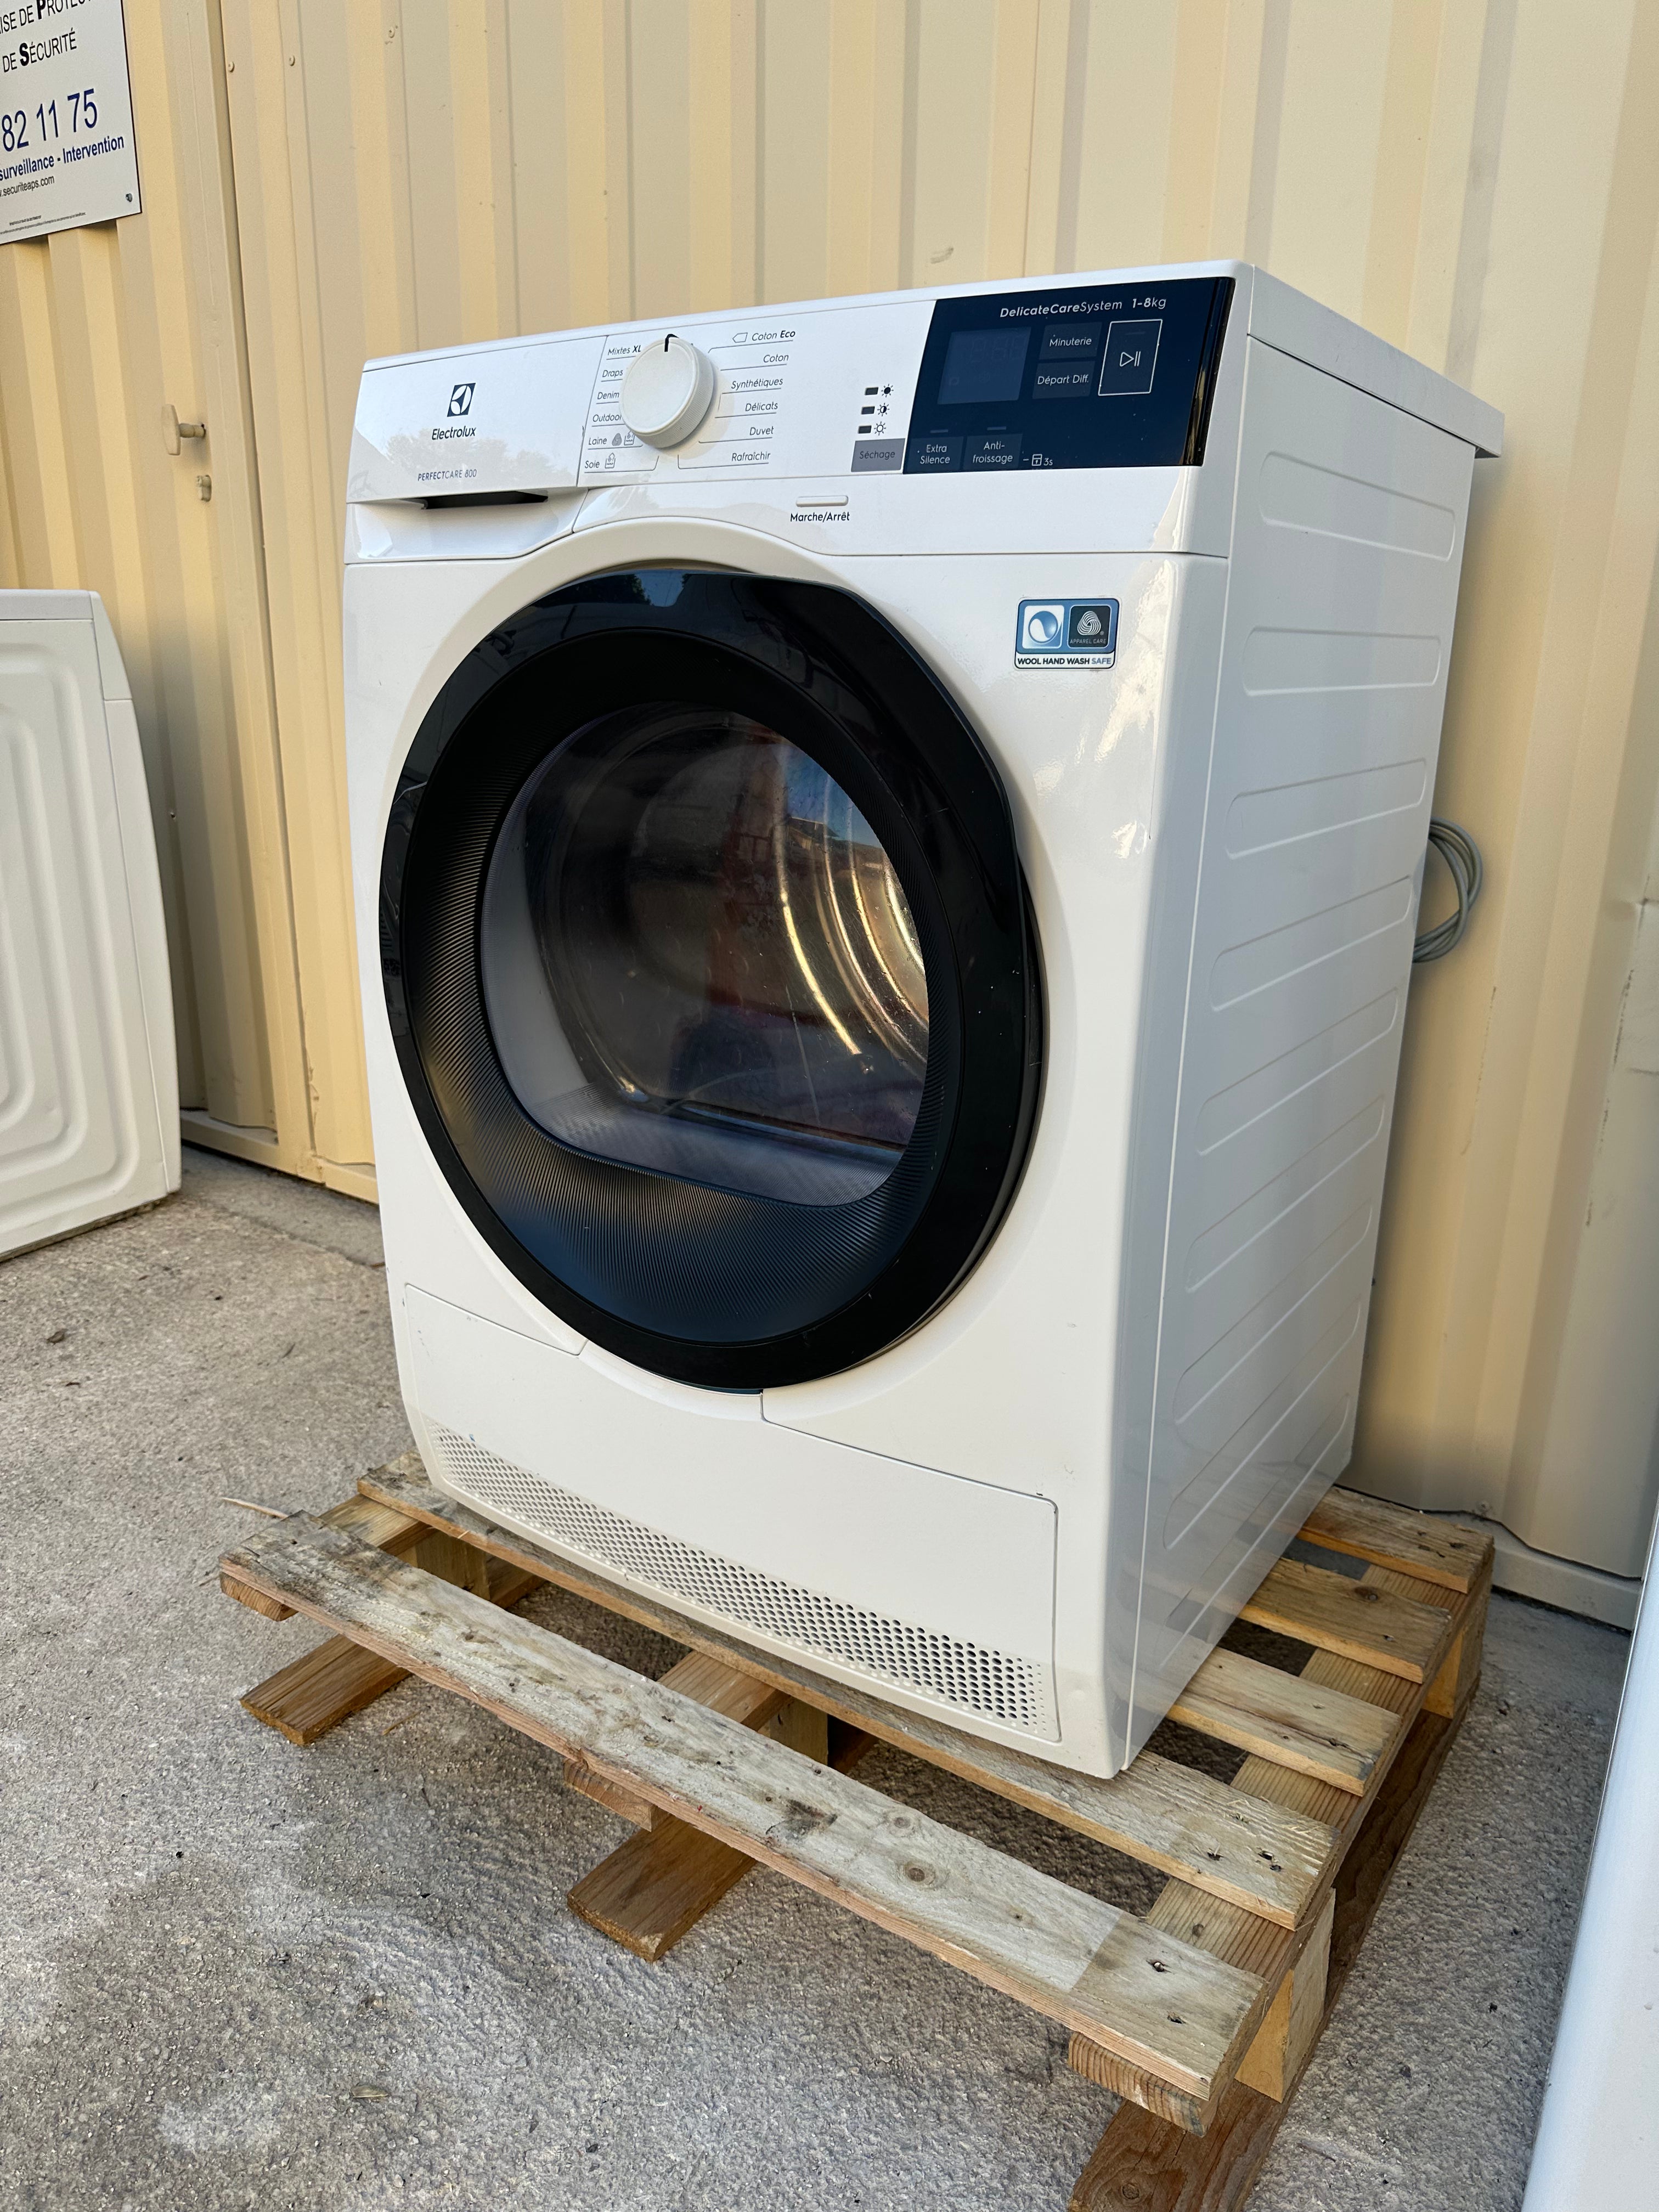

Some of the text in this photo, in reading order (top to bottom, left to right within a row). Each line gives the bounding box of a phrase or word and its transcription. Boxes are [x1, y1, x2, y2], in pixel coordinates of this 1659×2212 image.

[0, 0, 91, 34] ISE DE PROT
[2, 27, 77, 72] DE SÉCURITÉ
[2, 88, 98, 152] 82 11 75
[63, 136, 124, 163] Intervention
[1000, 297, 1166, 318] DelicateCareSystem 1-8kg
[752, 332, 777, 341] Coton
[1049, 336, 1092, 347] Minuterie
[608, 345, 641, 356] Mixtes XL
[763, 354, 789, 363] Coton
[602, 369, 623, 378] Draps
[731, 378, 783, 391] Synthétiques
[1037, 374, 1089, 386] Départ Diff.
[597, 391, 619, 399] Denim
[745, 402, 778, 411] Délicats
[432, 426, 476, 440] Electrolux
[749, 426, 774, 436] Duvet
[588, 437, 607, 445] Laine
[983, 441, 1005, 450] Anti-
[926, 444, 947, 453] Extra
[731, 451, 771, 461] Rafraîchir
[859, 450, 895, 460] Séchage
[920, 456, 950, 464] Silence
[972, 454, 1013, 465] froissage
[584, 460, 600, 469] Soie
[1043, 458, 1053, 466] 3s
[418, 469, 477, 481] PERFECTCARE 800
[790, 511, 850, 522] Marche/Arrêt
